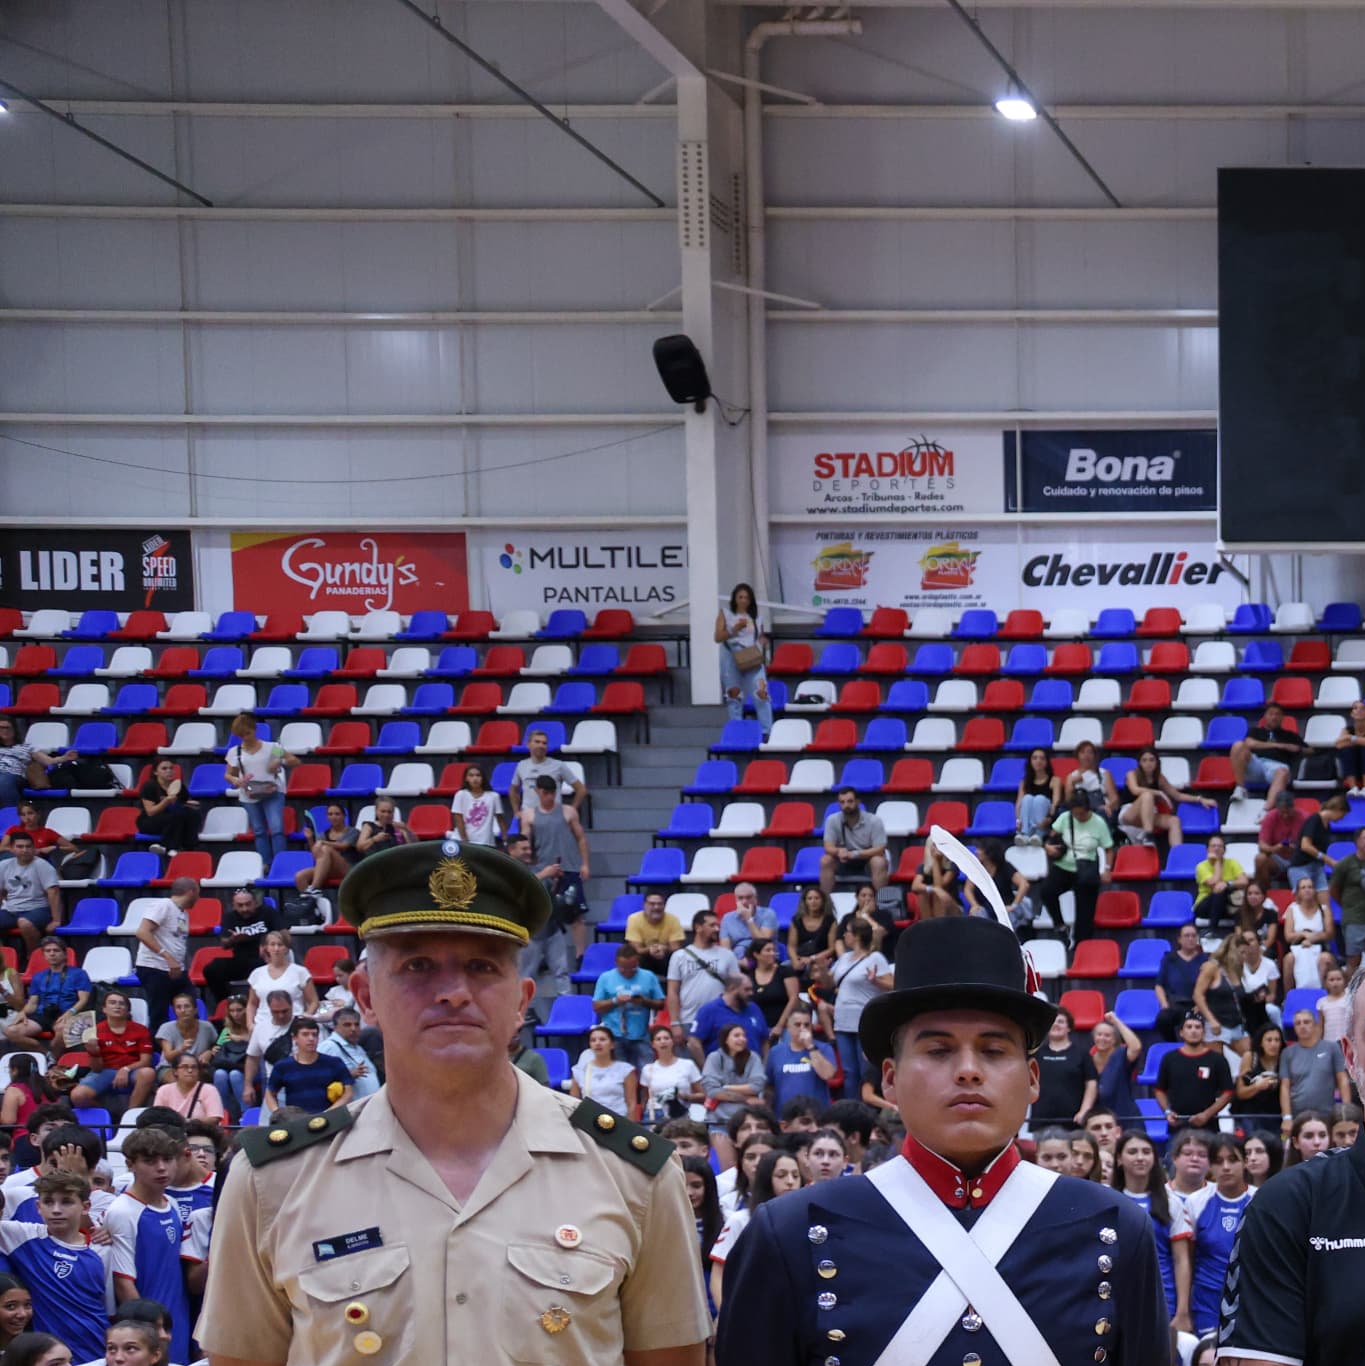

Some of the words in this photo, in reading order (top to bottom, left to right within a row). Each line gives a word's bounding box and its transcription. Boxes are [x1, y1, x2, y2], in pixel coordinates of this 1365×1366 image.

[814, 451, 954, 479] STADIUM
[1064, 448, 1175, 482] Bona
[812, 478, 956, 492] DEPORTES
[1043, 486, 1087, 497] Cuidado
[1090, 488, 1096, 497] y
[1098, 485, 1155, 496] renovación
[1158, 486, 1172, 496] de
[1174, 486, 1203, 497] pisos
[142, 556, 177, 578] SPEED
[529, 546, 689, 570] MULTILE
[19, 550, 126, 591] LIDER
[281, 538, 419, 612] Gundy's
[1021, 551, 1225, 588] Chevallier
[326, 586, 388, 596] PANADERIAS
[543, 585, 676, 604] PANTALLAS
[234, 921, 268, 936] VANS
[782, 1063, 811, 1074] PUMA
